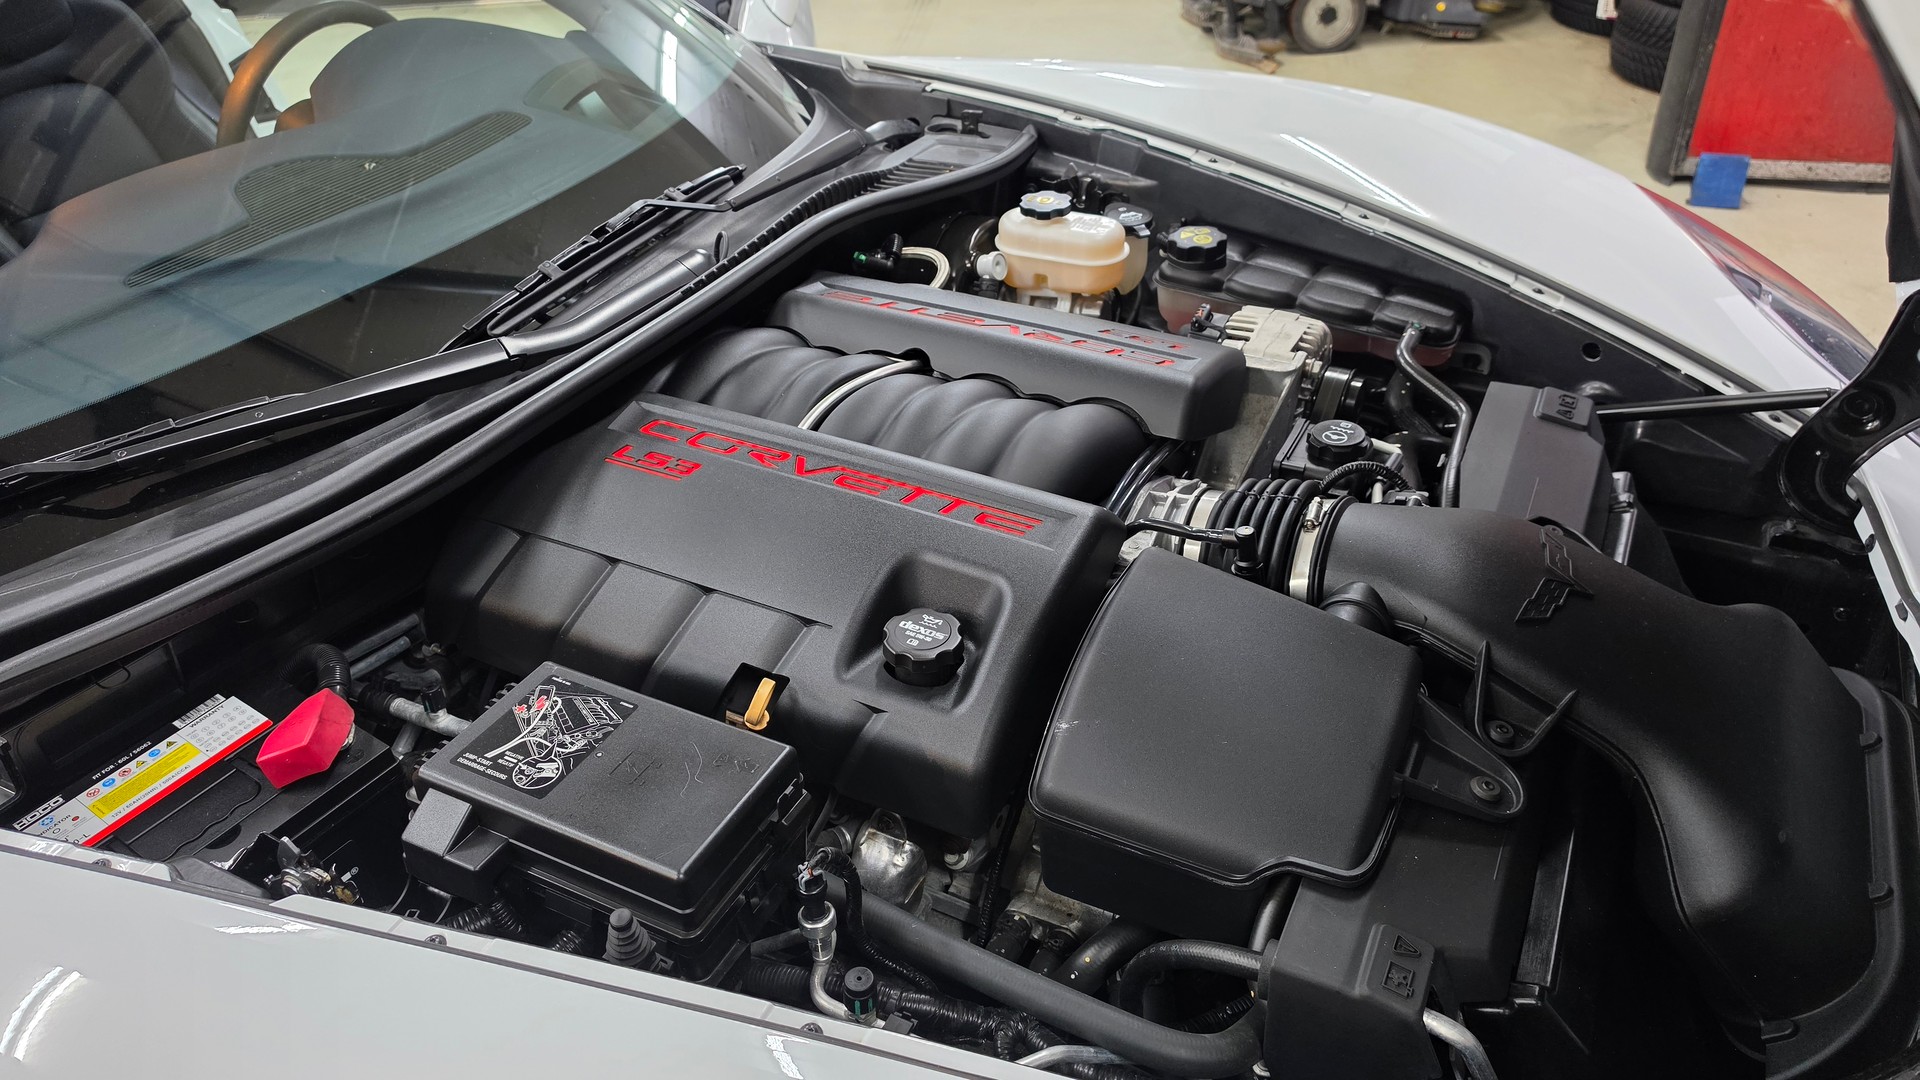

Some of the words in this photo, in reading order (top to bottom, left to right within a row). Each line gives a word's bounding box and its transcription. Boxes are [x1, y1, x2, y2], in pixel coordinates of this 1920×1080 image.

[821, 291, 1177, 366] CORVETTE
[605, 444, 703, 479] LS3
[638, 419, 1043, 536] CORVETTE
[899, 621, 946, 640] dexos
[189, 705, 224, 728] WARRANTY
[101, 764, 115, 774] FOR
[463, 752, 493, 766] JUMP-START
[40, 814, 71, 836] NDICATOR
